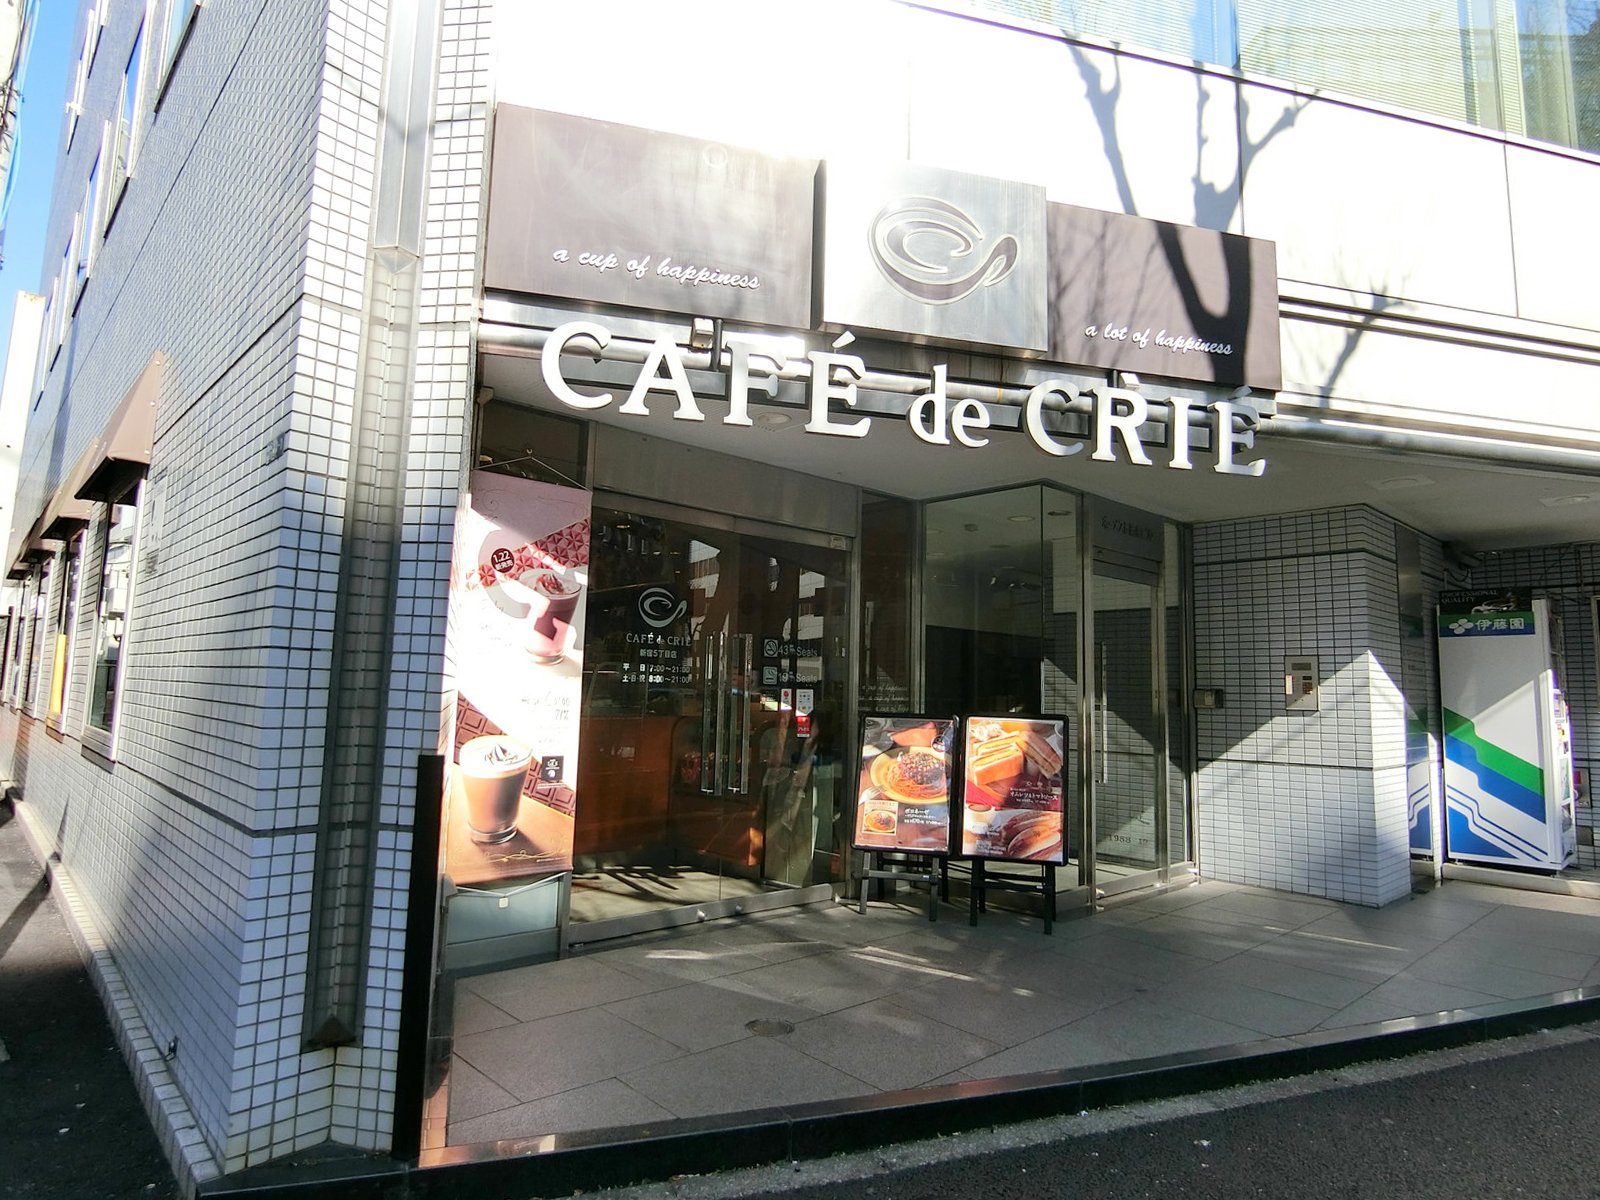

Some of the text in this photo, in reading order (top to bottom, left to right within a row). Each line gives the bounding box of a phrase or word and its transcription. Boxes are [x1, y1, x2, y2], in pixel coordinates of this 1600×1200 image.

[552, 249, 761, 290] a cup of happiness
[1085, 322, 1233, 356] a lot of happiness
[541, 320, 1267, 477] CAFÉ de CRIÉ
[493, 550, 511, 563] 1.22
[495, 559, 514, 571] 新発売
[1441, 589, 1499, 598] PROFESSIONAL
[1441, 596, 1475, 604] QUALITY
[1475, 617, 1525, 632] 伊藤園
[626, 632, 655, 645] CAFÉ
[640, 649, 677, 659] 新宿5丁目店
[796, 646, 818, 657] Seats
[796, 672, 818, 684] Seats
[1108, 833, 1132, 844] 1988
